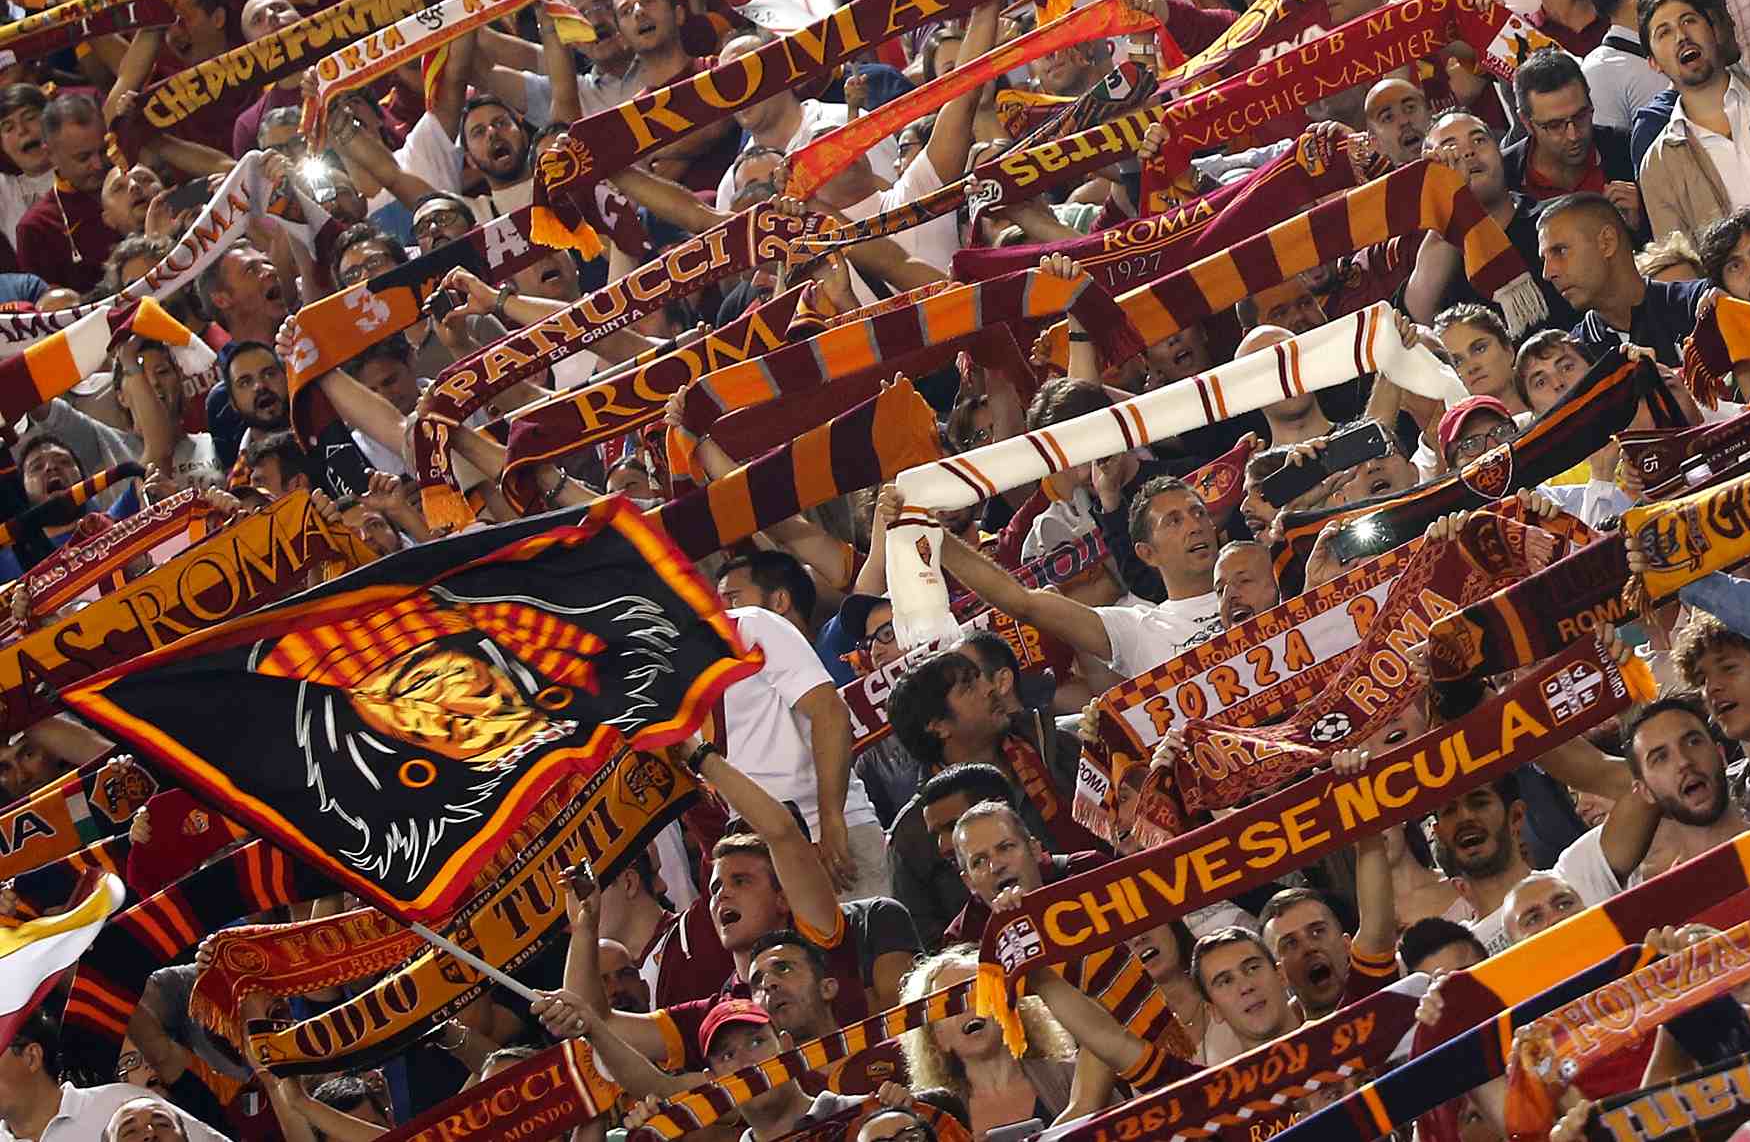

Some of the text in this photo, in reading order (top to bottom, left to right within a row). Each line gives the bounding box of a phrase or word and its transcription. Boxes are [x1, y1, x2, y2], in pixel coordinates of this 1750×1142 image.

[1245, 31, 1349, 89] CLUB
[1182, 87, 1308, 149] VECCHIE
[1102, 198, 1215, 253] ROMA
[1105, 253, 1163, 287] 1927
[433, 225, 733, 410] PANUCCI
[119, 503, 354, 652] ROMA
[1317, 571, 1388, 614] DISCUTE
[1142, 627, 1317, 739] FORZA
[1346, 589, 1459, 719] ROMA
[294, 793, 627, 1059] ODIO TUTTI
